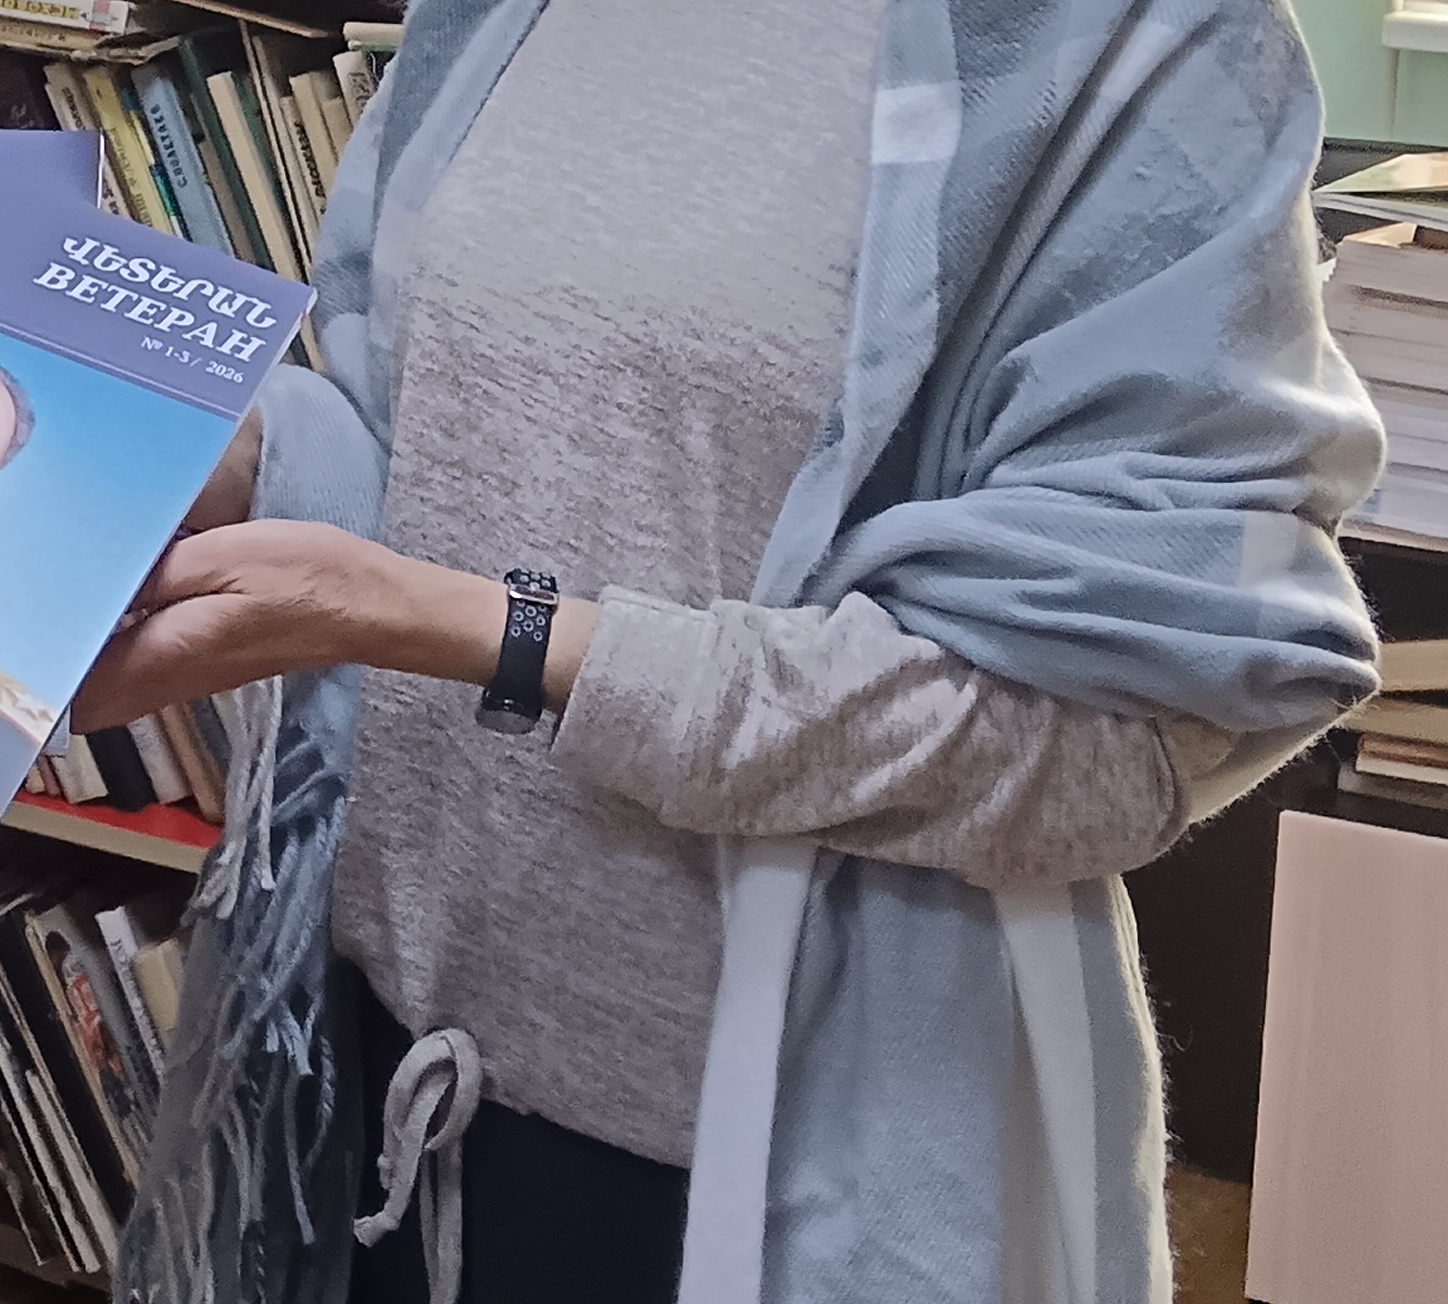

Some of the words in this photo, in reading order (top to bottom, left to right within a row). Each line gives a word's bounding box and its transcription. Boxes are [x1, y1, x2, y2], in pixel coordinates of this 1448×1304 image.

[32, 262, 267, 362] ВЕТЕРАН
[62, 236, 277, 328] ՎԵՏԵՐԱՆ
[205, 360, 245, 384] 2026
